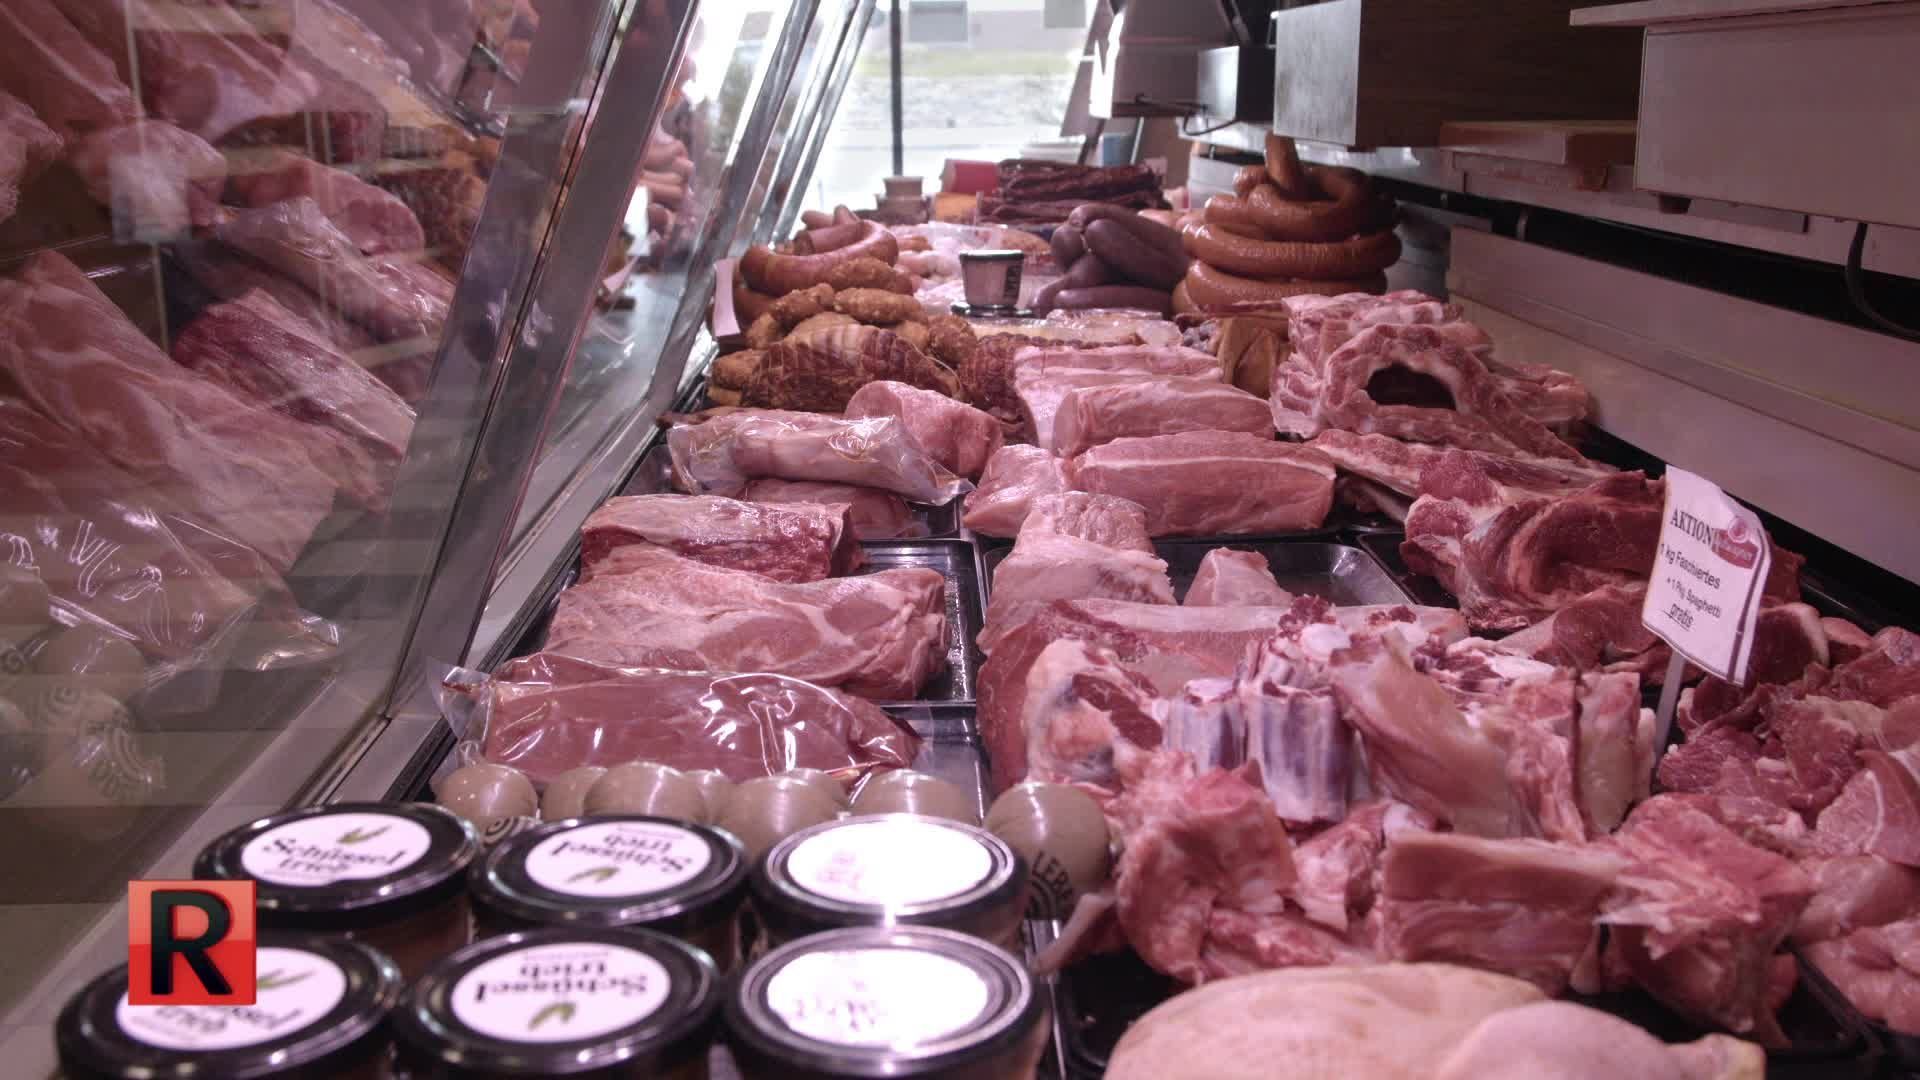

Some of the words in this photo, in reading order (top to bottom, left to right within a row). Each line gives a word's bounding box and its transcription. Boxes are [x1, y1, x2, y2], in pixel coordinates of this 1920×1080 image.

[1670, 508, 1712, 547] AKTION
[1665, 545, 1676, 565] kg
[1676, 551, 1721, 590] Faschiertes
[1669, 603, 1694, 629] gratis
[520, 963, 606, 980] trieb
[475, 974, 648, 1002] Schüssel
